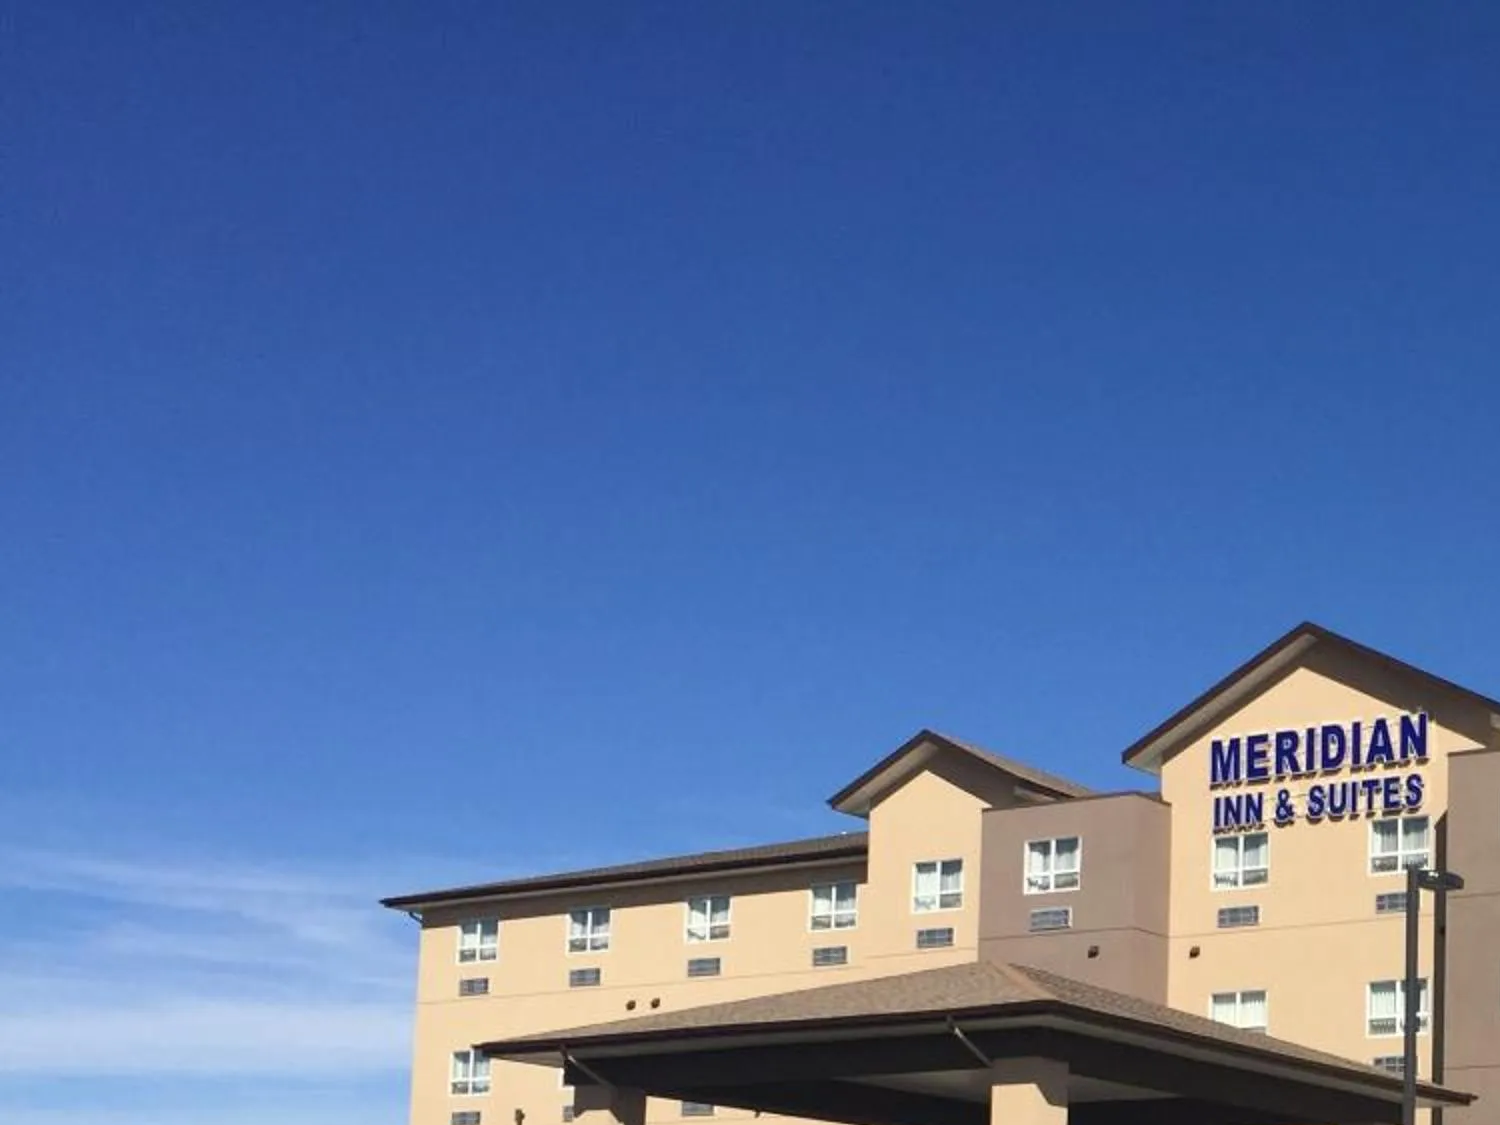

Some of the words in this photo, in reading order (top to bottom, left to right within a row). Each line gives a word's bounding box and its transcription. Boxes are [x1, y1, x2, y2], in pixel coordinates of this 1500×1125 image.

[1210, 712, 1428, 783] MERIDIAN
[1214, 792, 1264, 828] INN
[1276, 788, 1294, 821] &
[1307, 773, 1423, 817] SUITES
